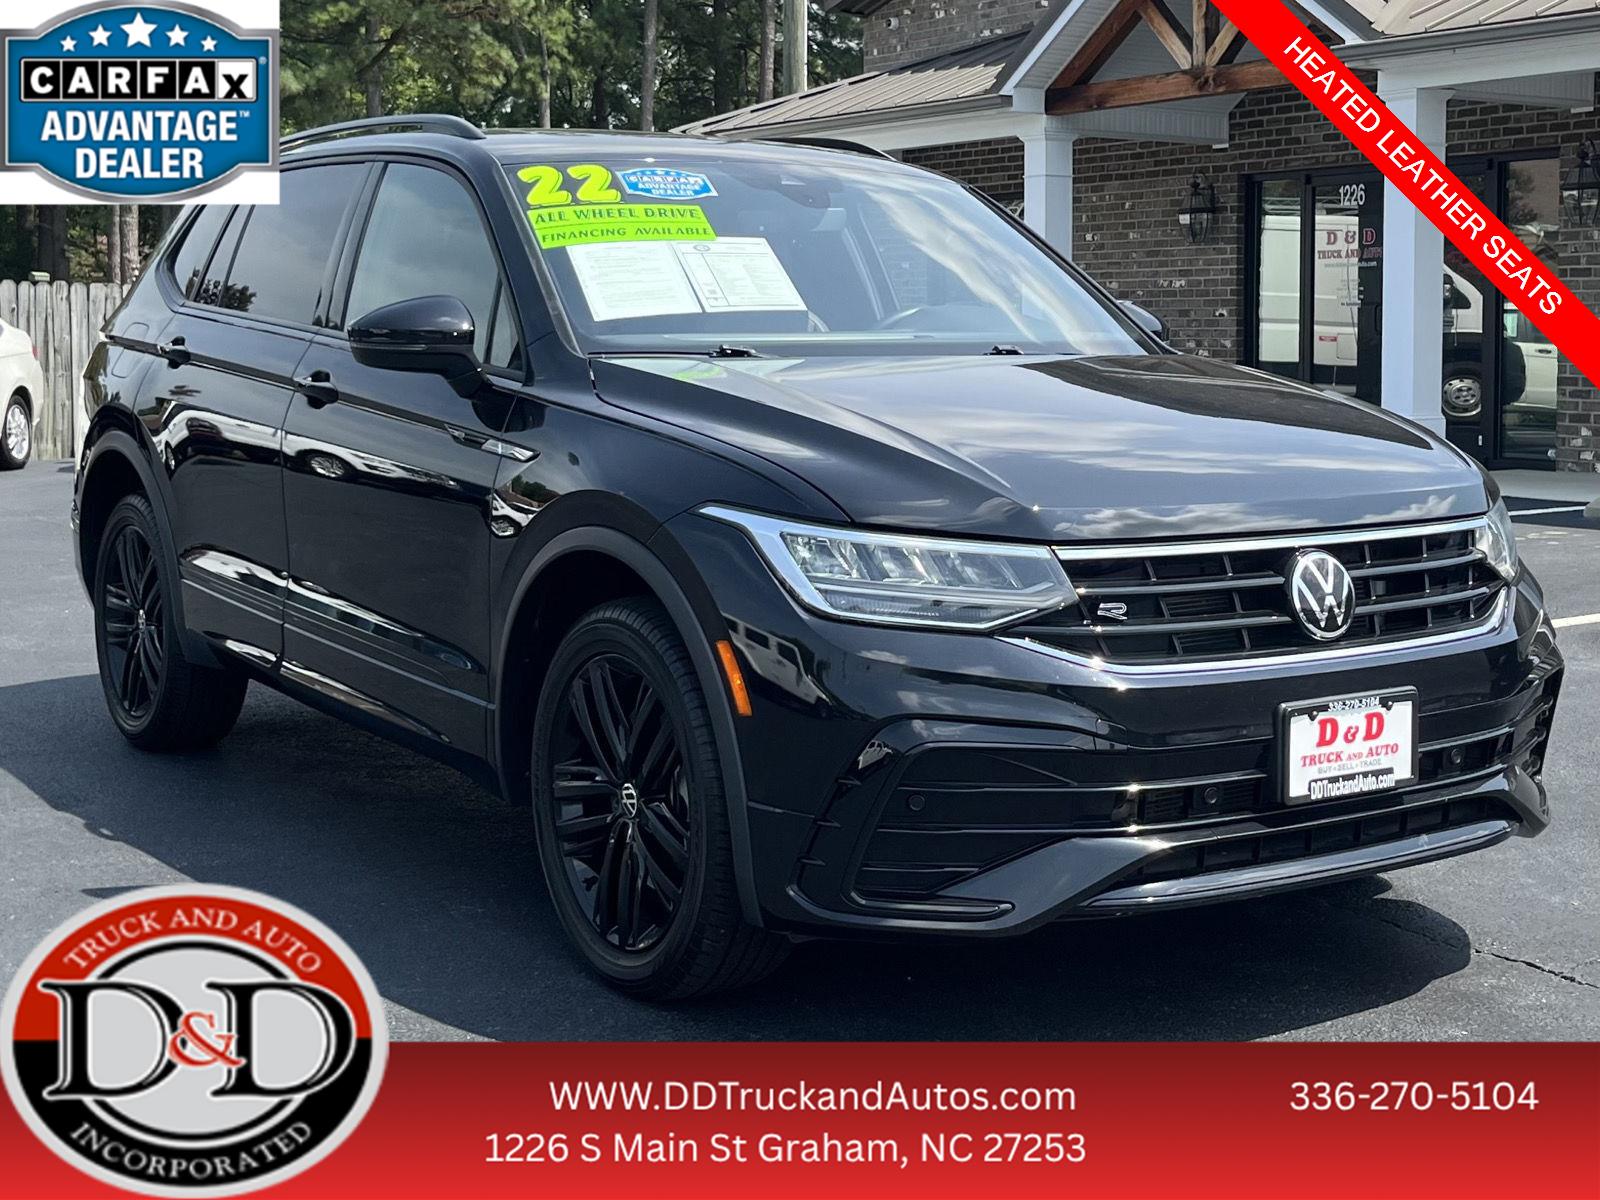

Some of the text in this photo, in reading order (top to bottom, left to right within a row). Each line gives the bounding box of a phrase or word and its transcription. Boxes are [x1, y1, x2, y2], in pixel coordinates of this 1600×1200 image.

[517, 164, 623, 206] 22
[1338, 184, 1366, 206] 1226
[535, 207, 701, 225] ALL WHEEL DRIVE
[541, 227, 711, 243] FINANCING AVAILABLE
[1326, 227, 1376, 246] D & D
[1317, 249, 1343, 260] TRUCK
[1344, 248, 1362, 259] AND
[1328, 696, 1381, 712] 336-270-5104
[1316, 711, 1385, 748] D & D
[1300, 742, 1399, 768] TRUCK AND AUTO
[1310, 773, 1396, 800] DDTruckandAuto.com
